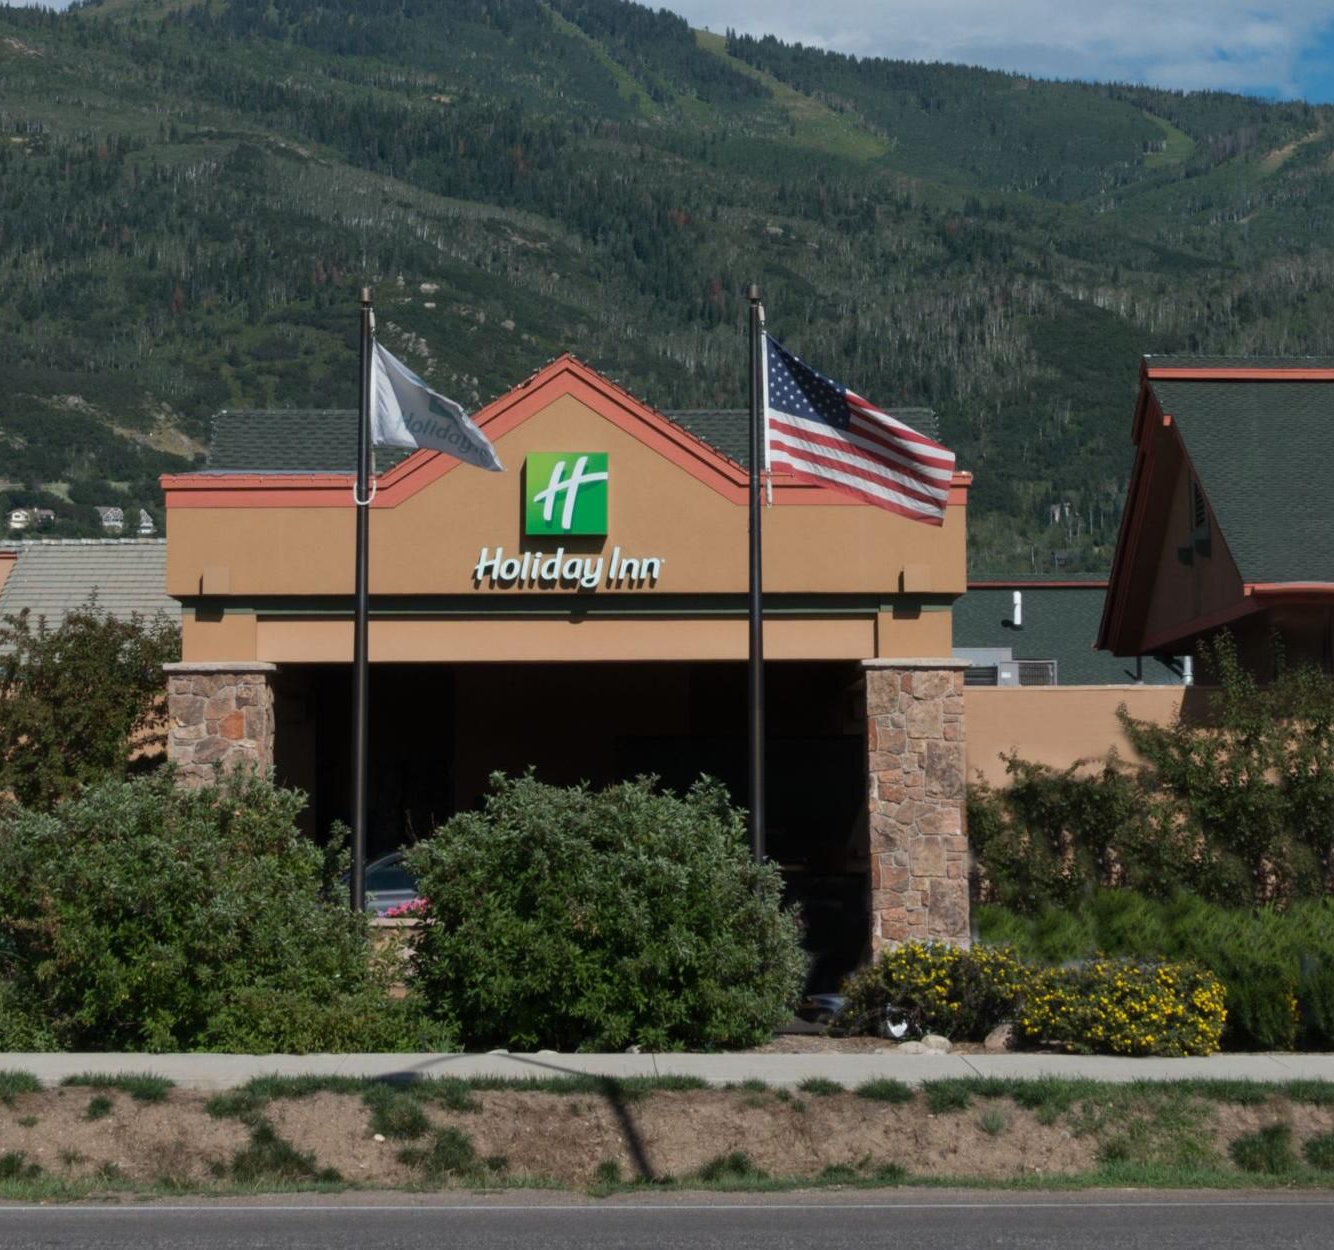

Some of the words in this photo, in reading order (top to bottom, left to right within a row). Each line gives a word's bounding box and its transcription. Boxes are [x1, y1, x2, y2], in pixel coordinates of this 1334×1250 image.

[533, 456, 608, 529] H
[475, 547, 604, 588] Holiday
[609, 546, 660, 580] Inn
